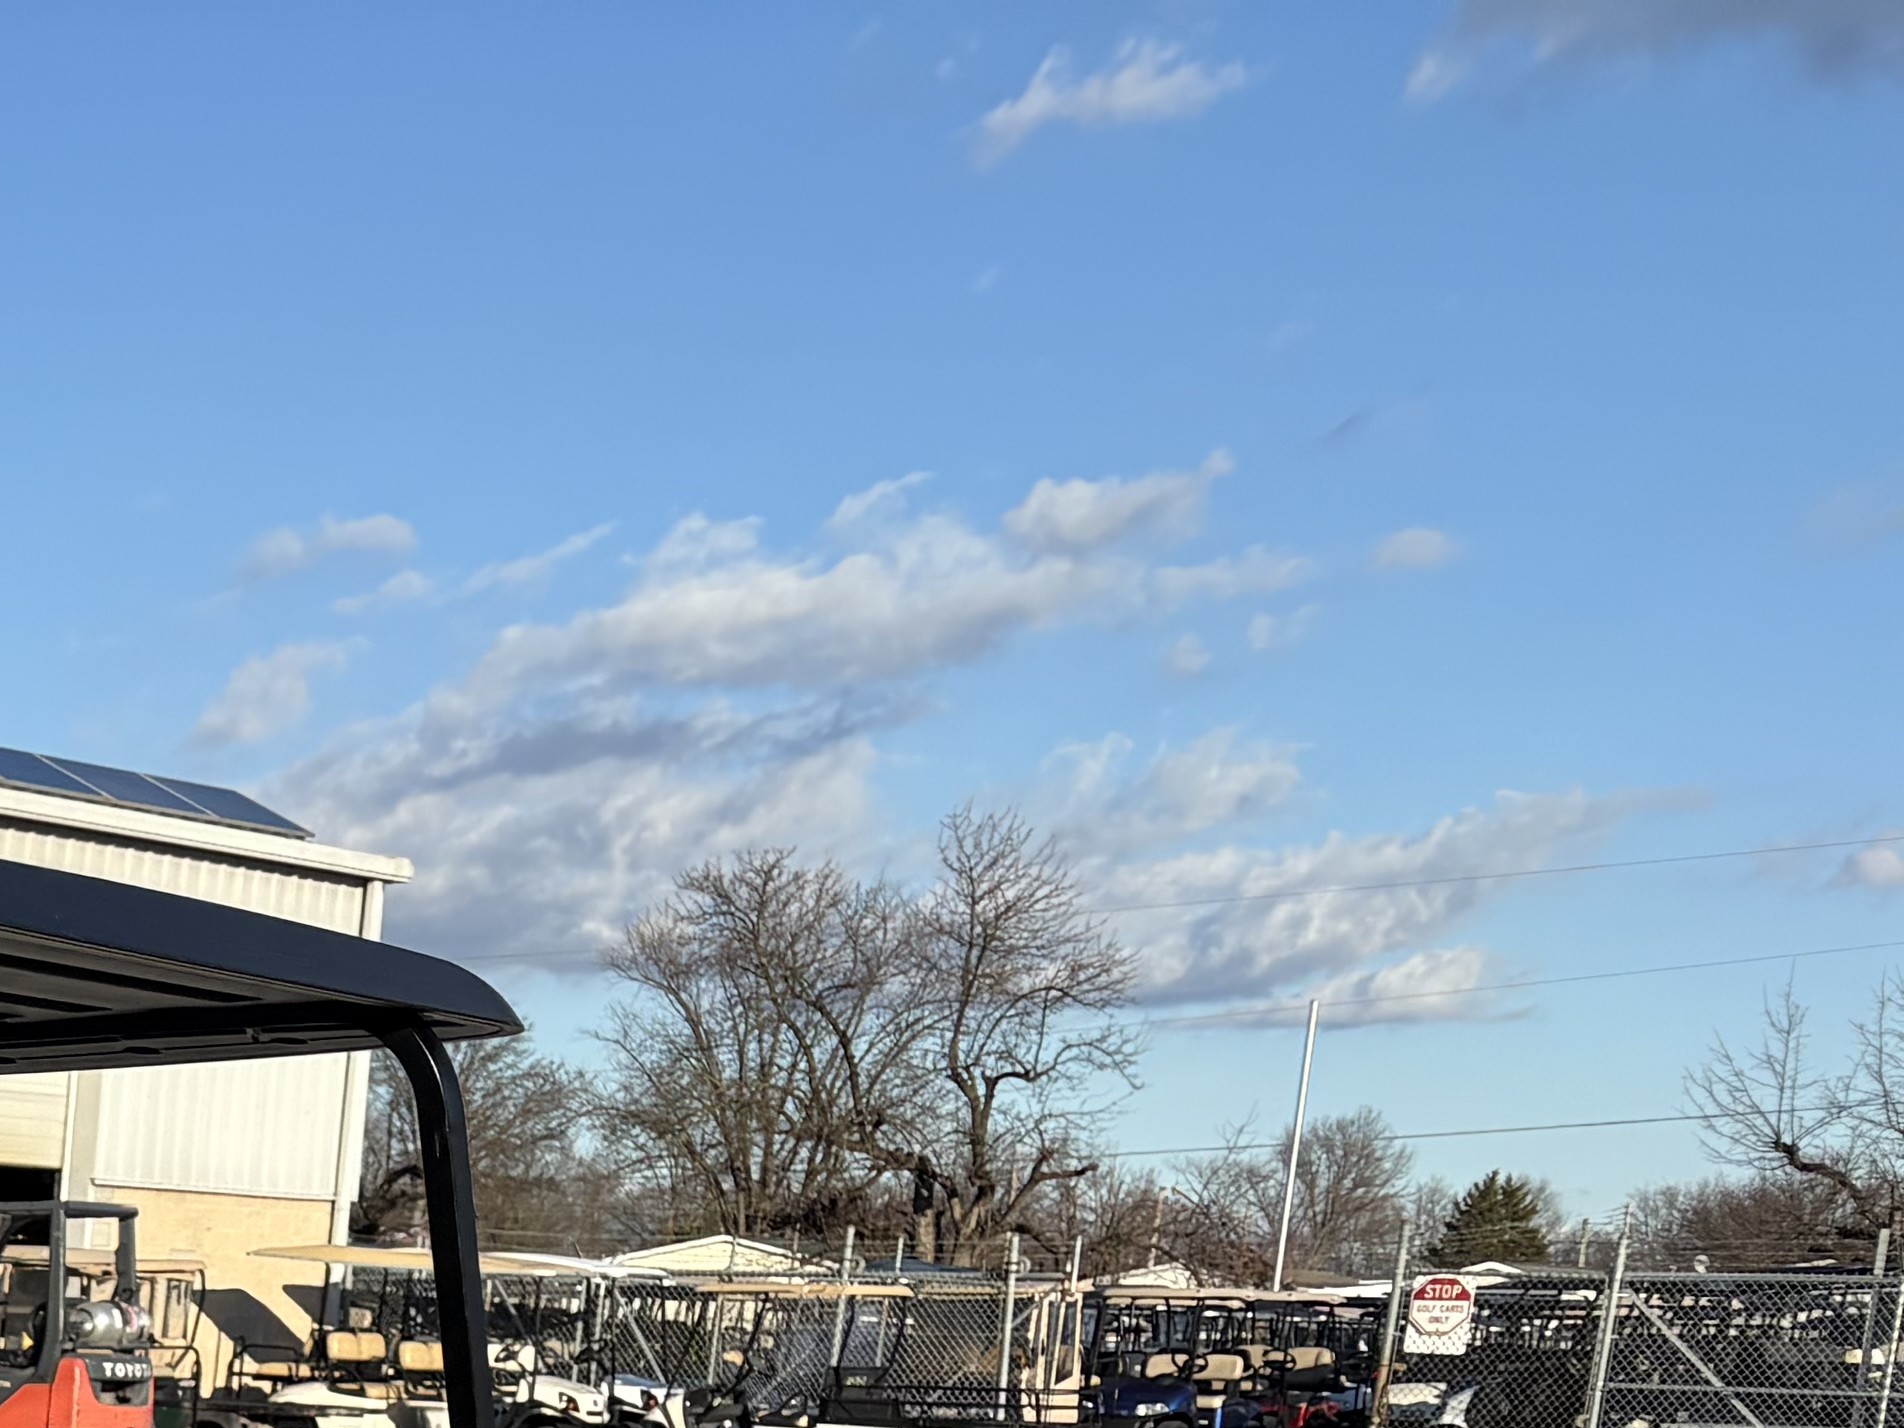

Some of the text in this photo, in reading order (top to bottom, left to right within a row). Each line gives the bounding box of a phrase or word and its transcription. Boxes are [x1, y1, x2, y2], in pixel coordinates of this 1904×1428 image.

[1424, 1284, 1463, 1299] STOP
[1416, 1304, 1436, 1313] GOLF
[1428, 1316, 1449, 1324] ONLY
